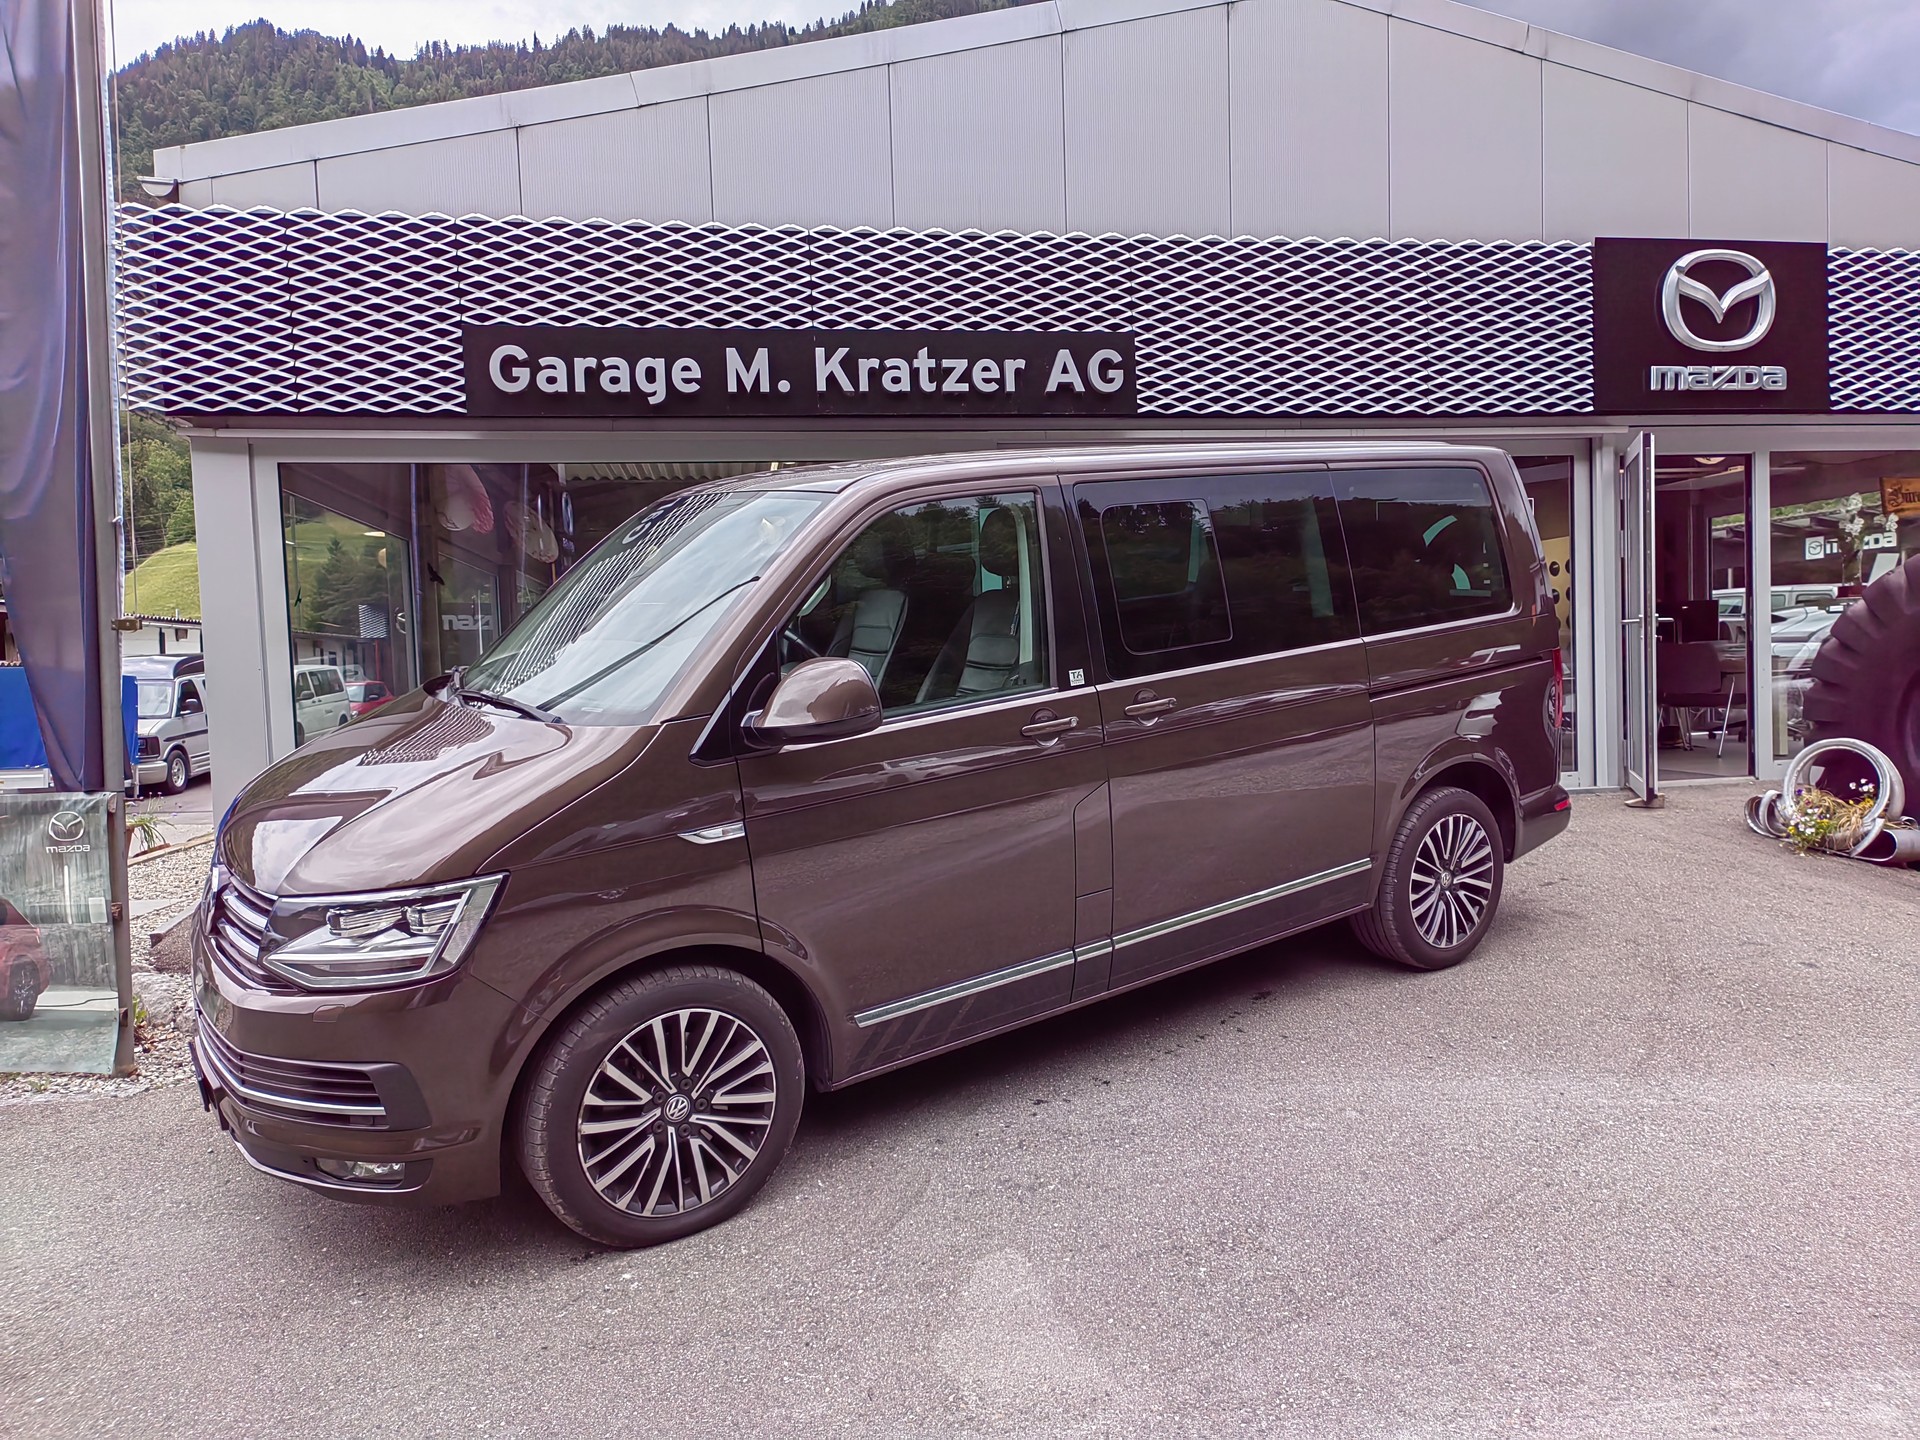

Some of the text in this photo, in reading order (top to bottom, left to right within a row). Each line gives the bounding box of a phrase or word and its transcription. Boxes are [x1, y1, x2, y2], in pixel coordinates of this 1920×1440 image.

[488, 344, 1125, 405] Garage M. Kratzer AG
[1650, 365, 1788, 391] mazda
[45, 844, 91, 854] mazda
